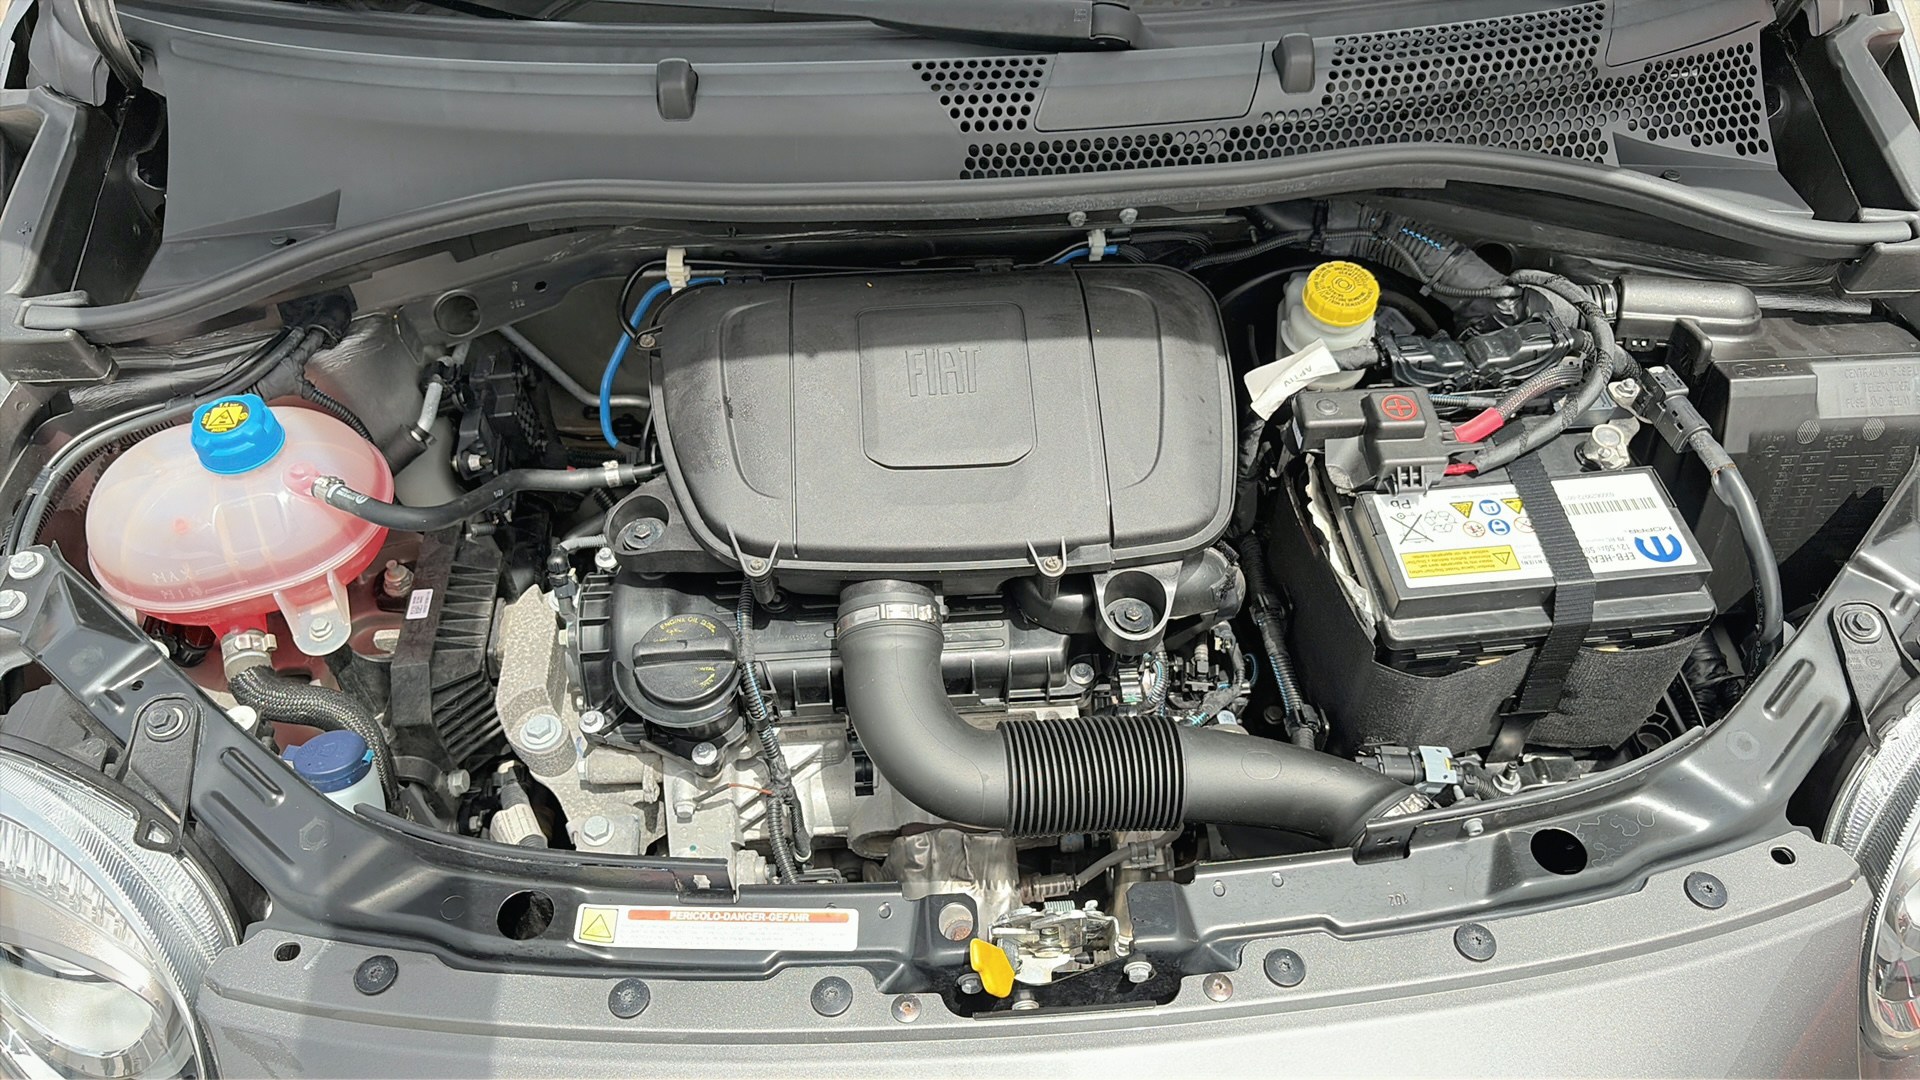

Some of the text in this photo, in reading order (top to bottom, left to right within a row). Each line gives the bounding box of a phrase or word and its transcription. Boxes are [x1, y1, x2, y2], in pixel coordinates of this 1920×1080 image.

[905, 346, 981, 397] FIAT
[1284, 365, 1313, 388] APTIV
[1391, 500, 1411, 510] Pb
[1586, 552, 1636, 564] EFB-HEAV
[152, 567, 193, 584] MAX
[161, 587, 202, 600] MIN
[660, 618, 685, 630] ENGINE
[670, 910, 810, 922] PERICOLO-DANGER-GEFAHR
